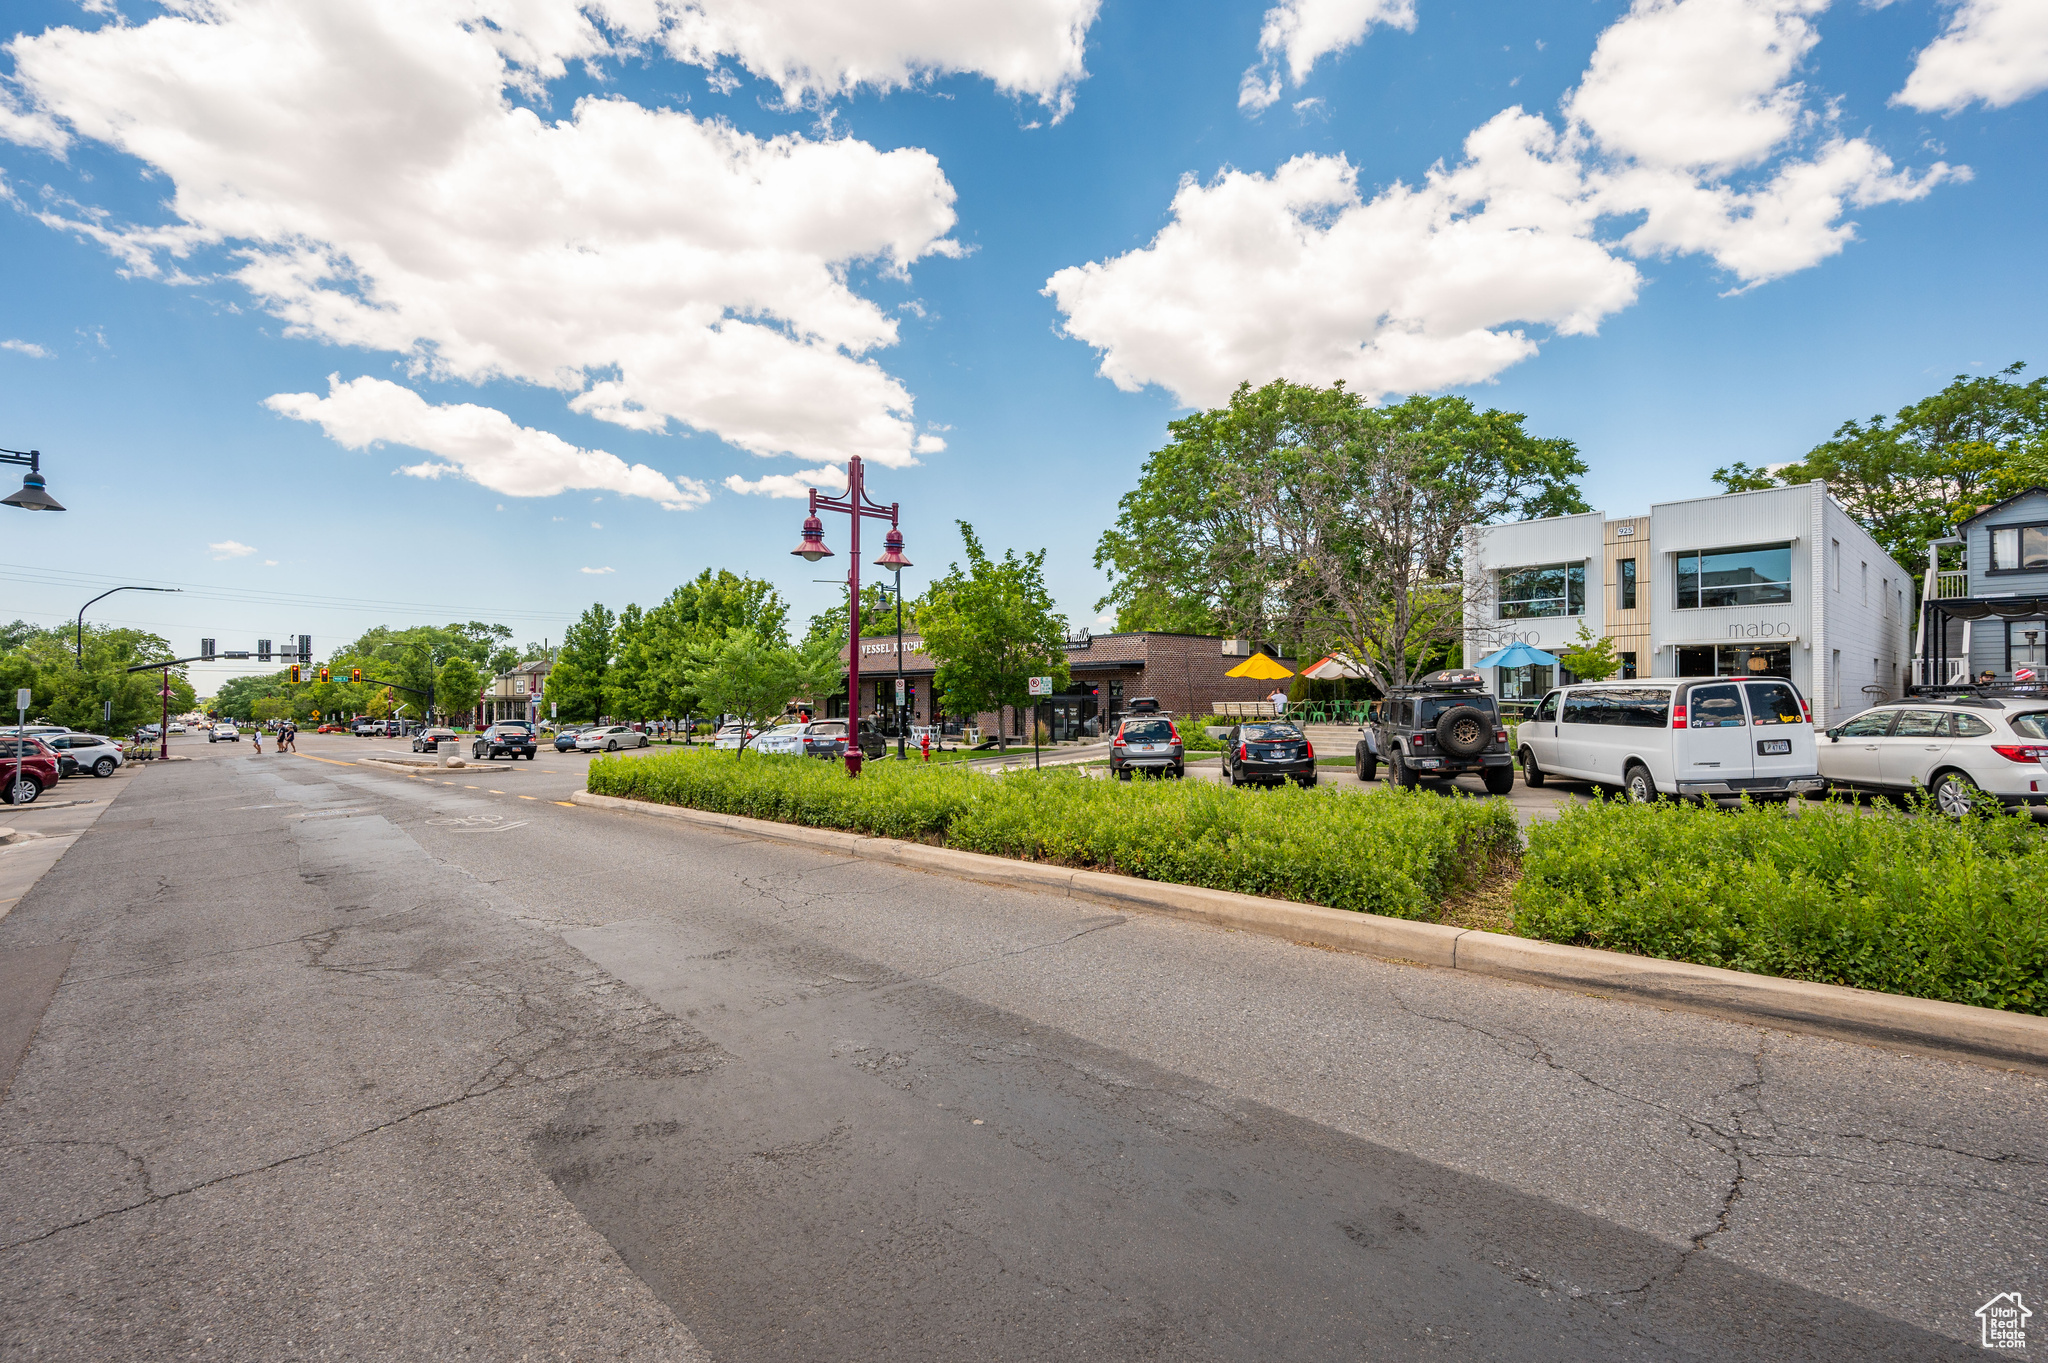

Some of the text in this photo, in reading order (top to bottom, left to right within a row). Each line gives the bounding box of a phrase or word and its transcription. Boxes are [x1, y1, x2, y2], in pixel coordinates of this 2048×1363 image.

[1070, 627, 1090, 642] milk
[1729, 620, 1790, 639] mabo
[862, 643, 891, 654] VESSEL
